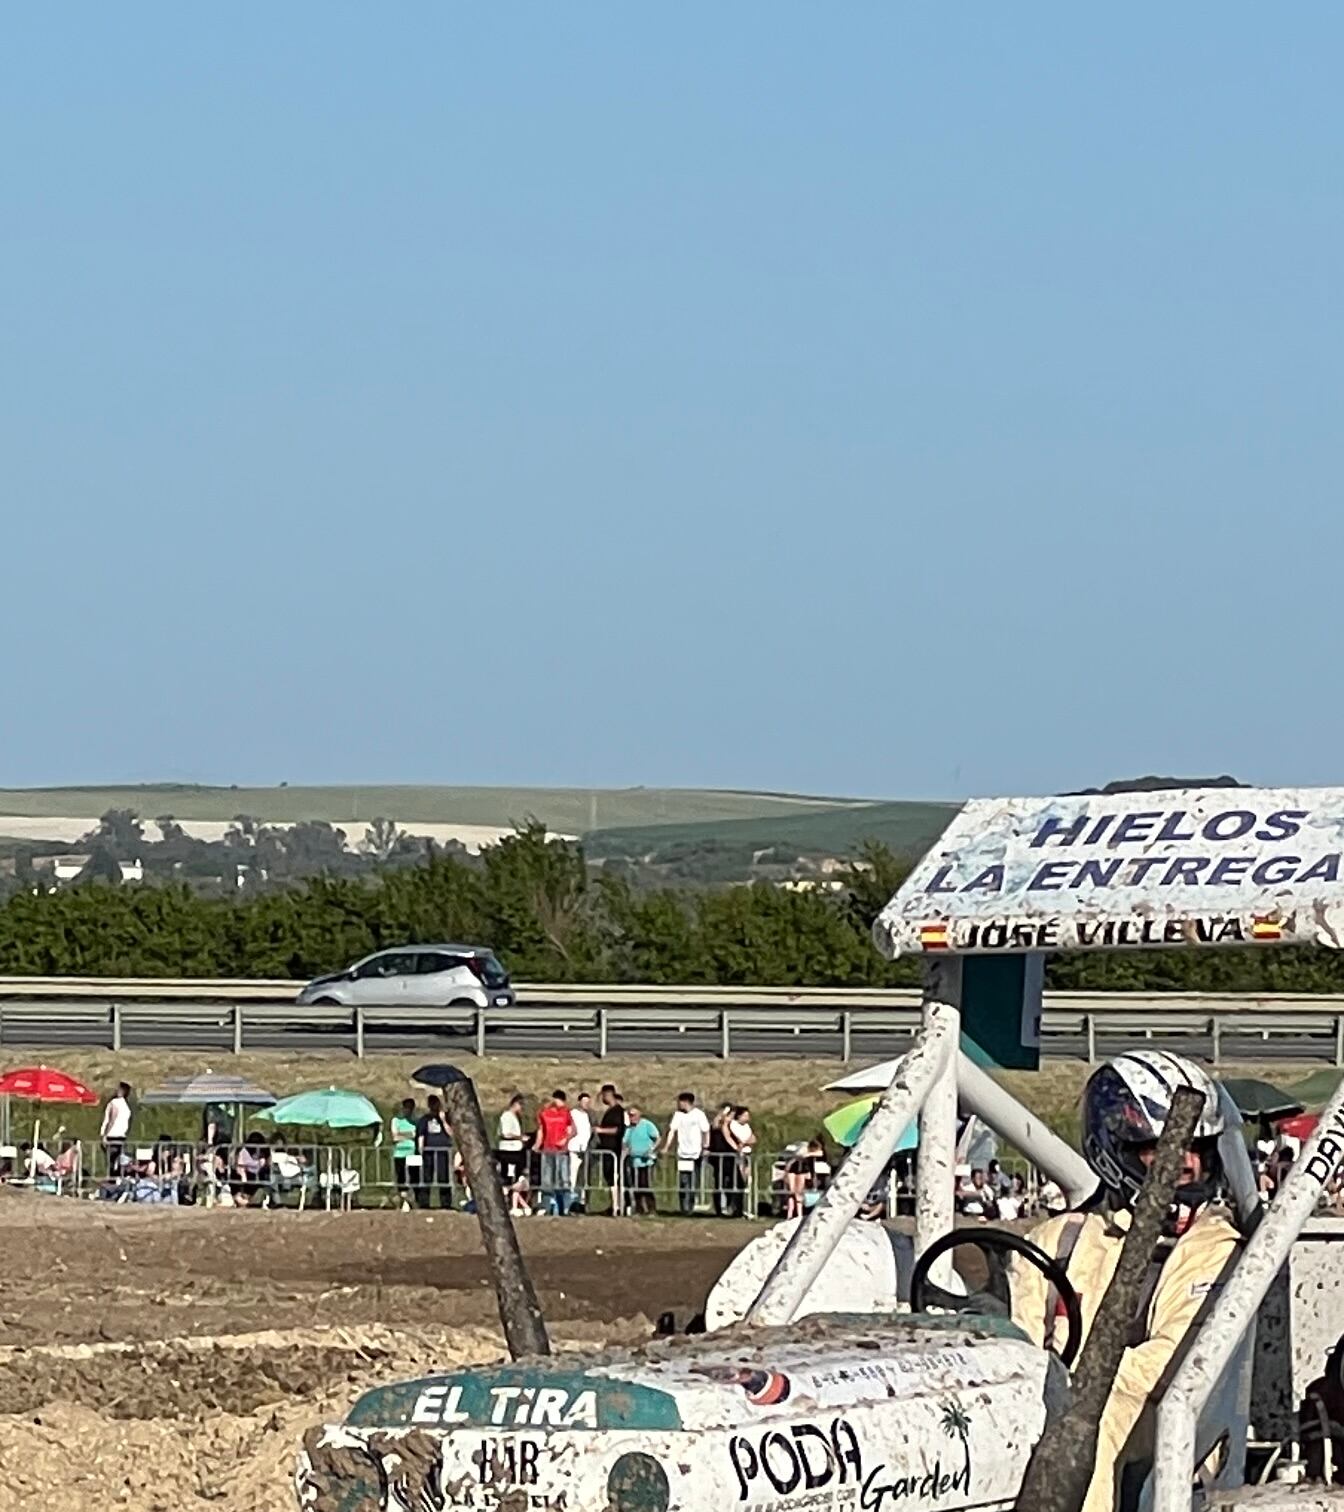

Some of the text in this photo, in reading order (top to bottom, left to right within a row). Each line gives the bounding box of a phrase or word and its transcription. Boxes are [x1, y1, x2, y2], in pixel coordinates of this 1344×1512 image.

[1030, 810, 1310, 848] HIELOS
[925, 852, 1342, 894] LA ENTREGA
[411, 1386, 469, 1423] EL
[730, 1418, 861, 1501] PODA
